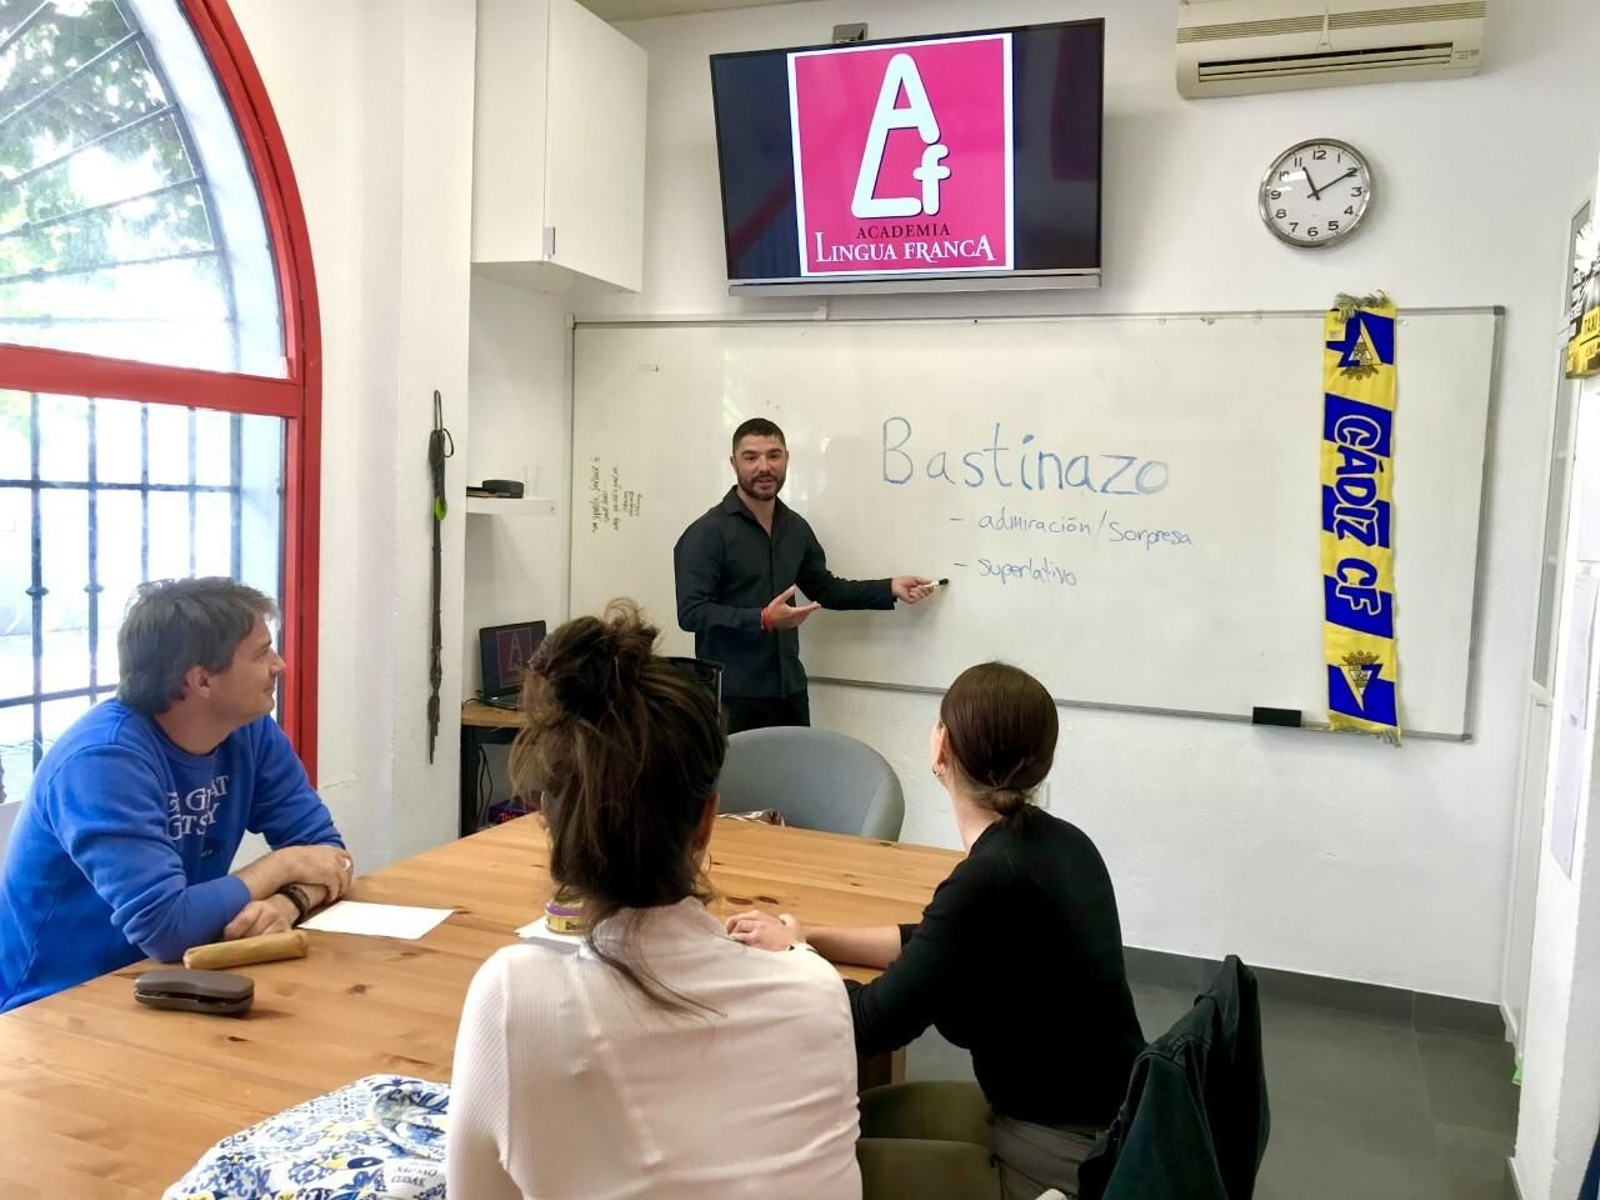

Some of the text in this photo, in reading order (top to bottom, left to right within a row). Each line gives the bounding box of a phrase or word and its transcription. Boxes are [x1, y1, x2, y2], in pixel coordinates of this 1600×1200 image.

[1312, 149, 1327, 161] 12
[1294, 157, 1302, 168] 11
[1270, 189, 1282, 200] 9
[1351, 186, 1362, 197] 3
[1275, 208, 1287, 219] 8
[1343, 205, 1354, 216] 4
[1289, 221, 1299, 232] 7
[1327, 220, 1340, 231] 5
[857, 224, 951, 239] ACADEMIA
[1307, 226, 1319, 237] 6
[815, 232, 996, 263] LINGUA FRANCA
[1333, 414, 1386, 616] CÁDIZ CF
